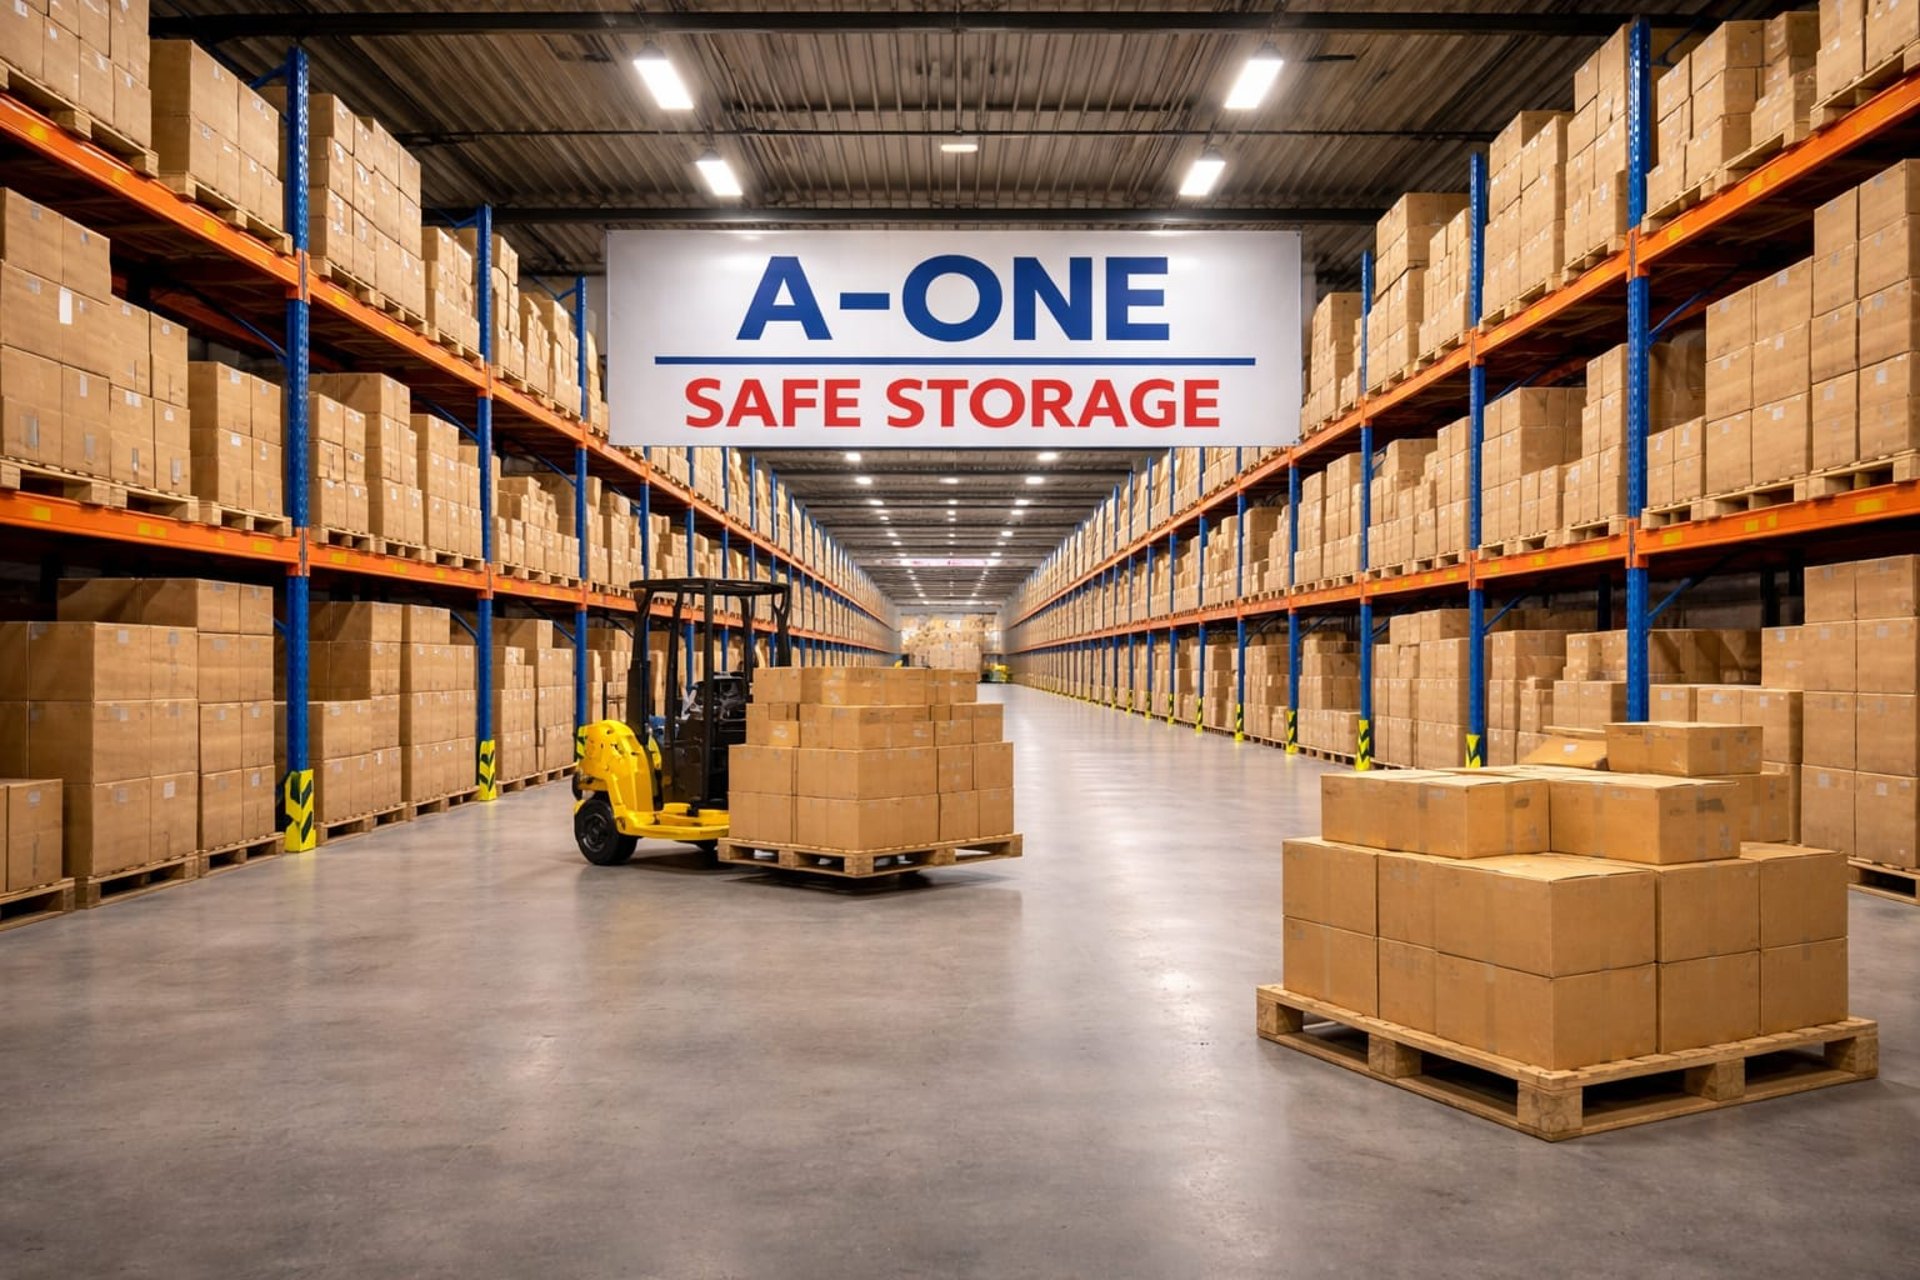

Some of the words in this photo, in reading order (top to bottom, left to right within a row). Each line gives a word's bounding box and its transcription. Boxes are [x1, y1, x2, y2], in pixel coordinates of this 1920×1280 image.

[736, 254, 1170, 343] A-ONE
[685, 377, 861, 429] SAFE
[886, 377, 1221, 429] STORAGE
